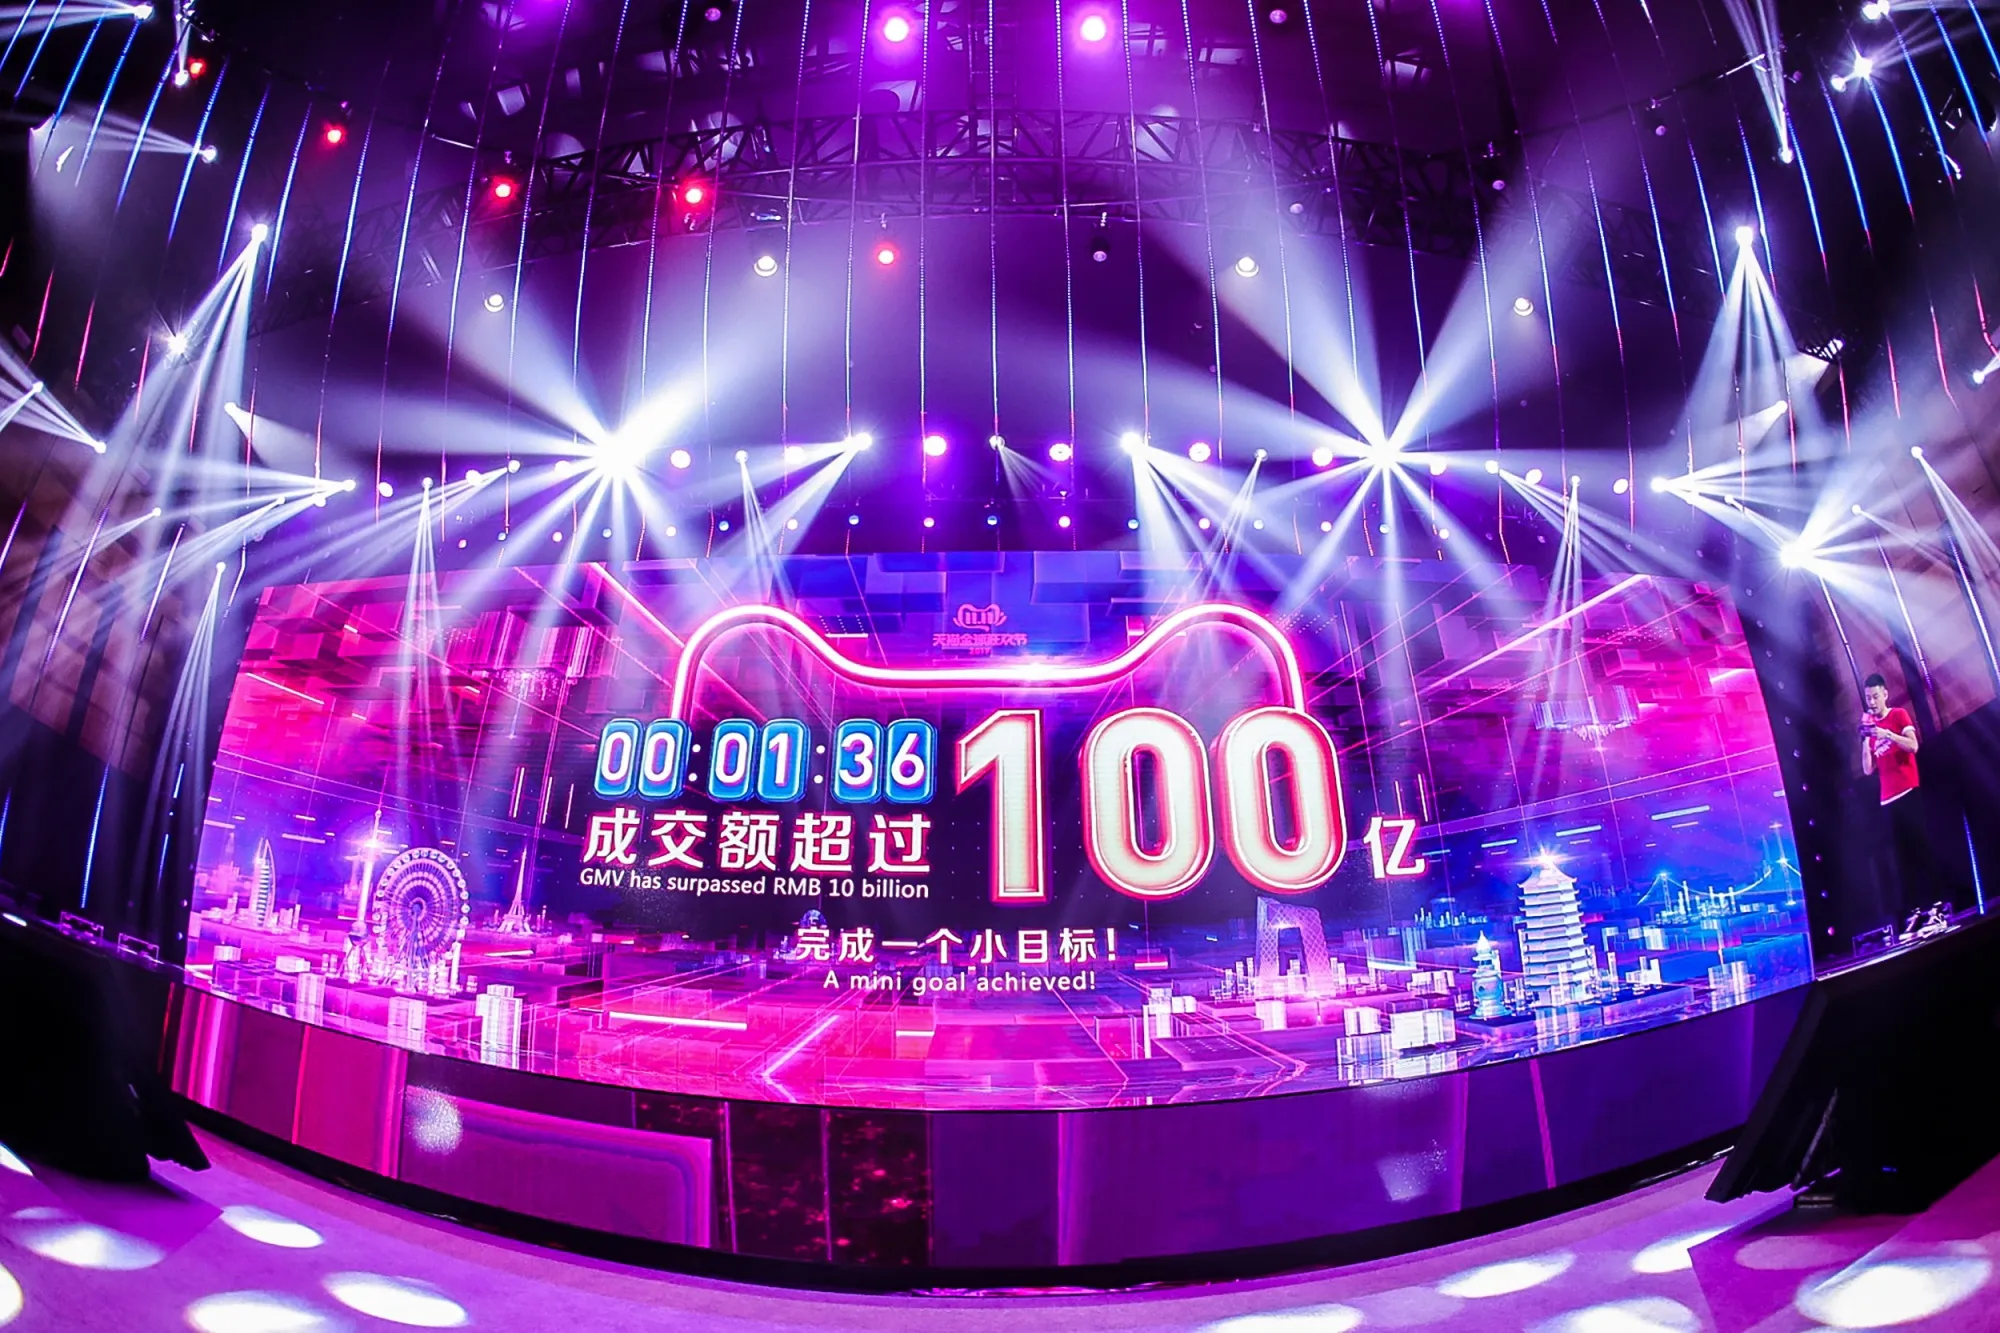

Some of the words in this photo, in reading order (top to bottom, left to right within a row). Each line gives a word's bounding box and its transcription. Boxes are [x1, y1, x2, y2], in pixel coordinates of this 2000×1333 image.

[582, 807, 932, 873] 成交额超过
[579, 867, 625, 887] GMV
[630, 872, 662, 891] has
[667, 875, 766, 896] surpassed
[773, 877, 821, 895] RMB
[829, 878, 855, 897] 10
[862, 879, 930, 899] billion
[823, 970, 840, 989] A
[850, 970, 902, 991] mini
[912, 972, 966, 996] goal
[976, 971, 1097, 992] achieved!
